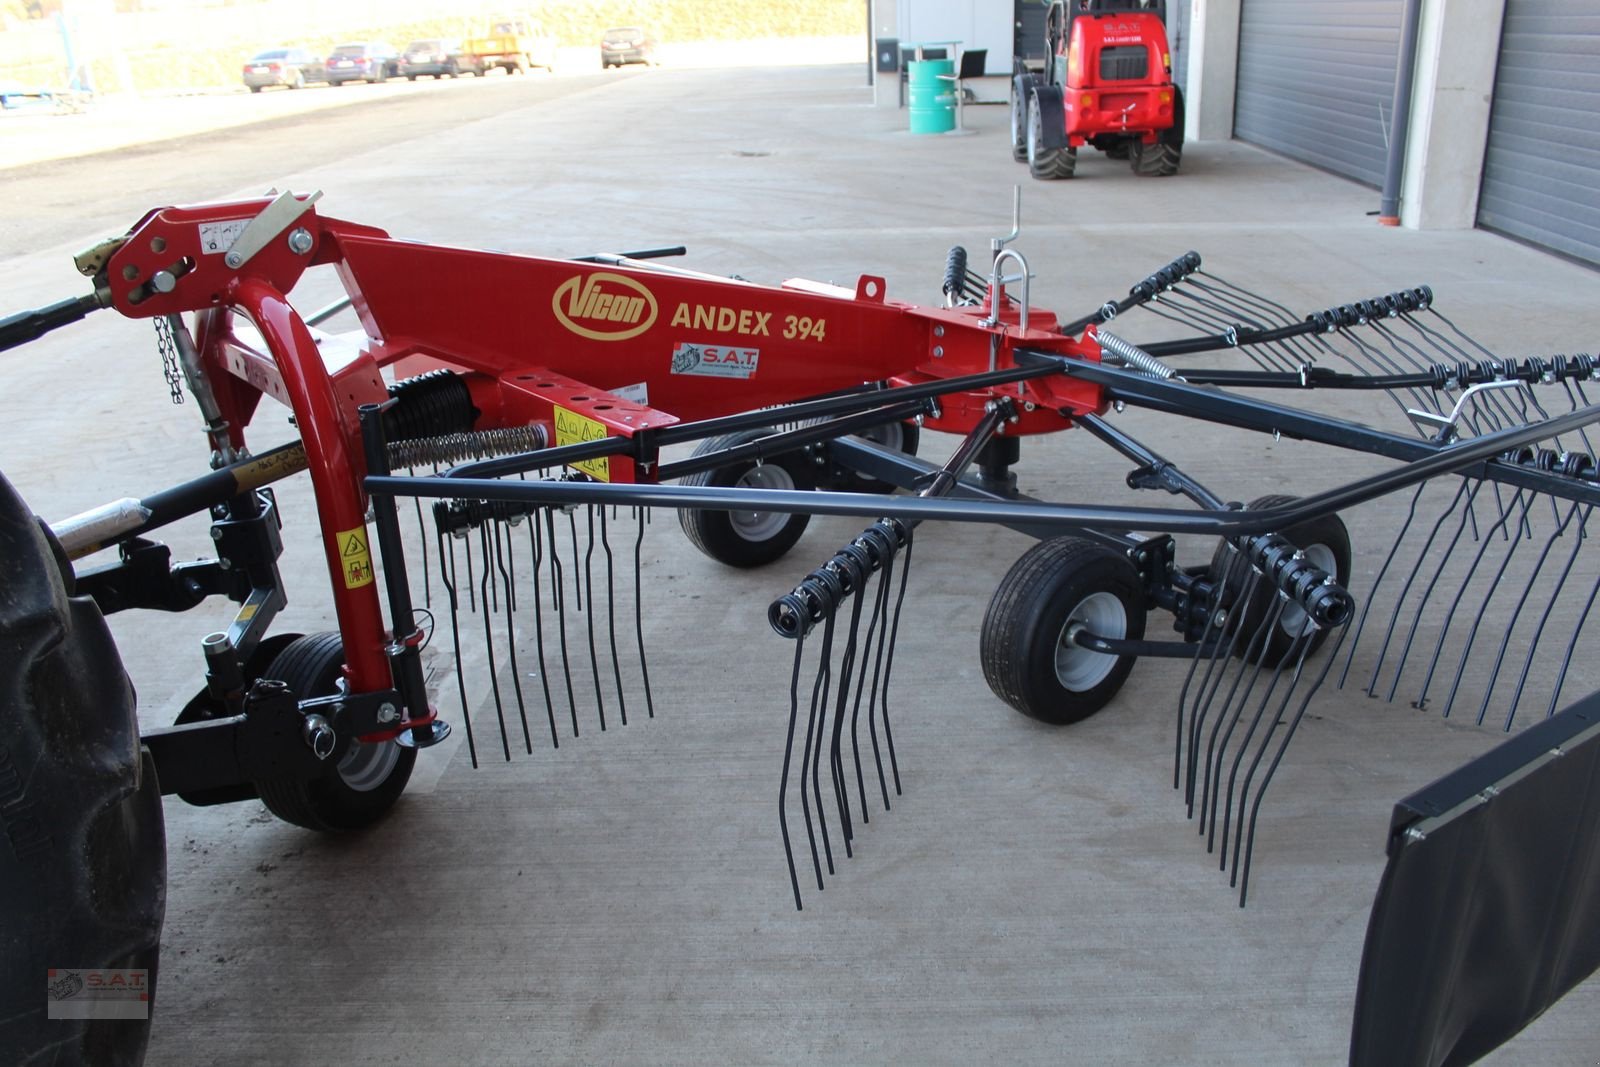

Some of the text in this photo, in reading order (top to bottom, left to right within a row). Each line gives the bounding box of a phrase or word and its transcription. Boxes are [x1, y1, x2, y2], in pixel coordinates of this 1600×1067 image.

[564, 272, 648, 325] Vicon
[670, 302, 826, 342] ANDEX 394
[703, 348, 757, 366] S.A.T.
